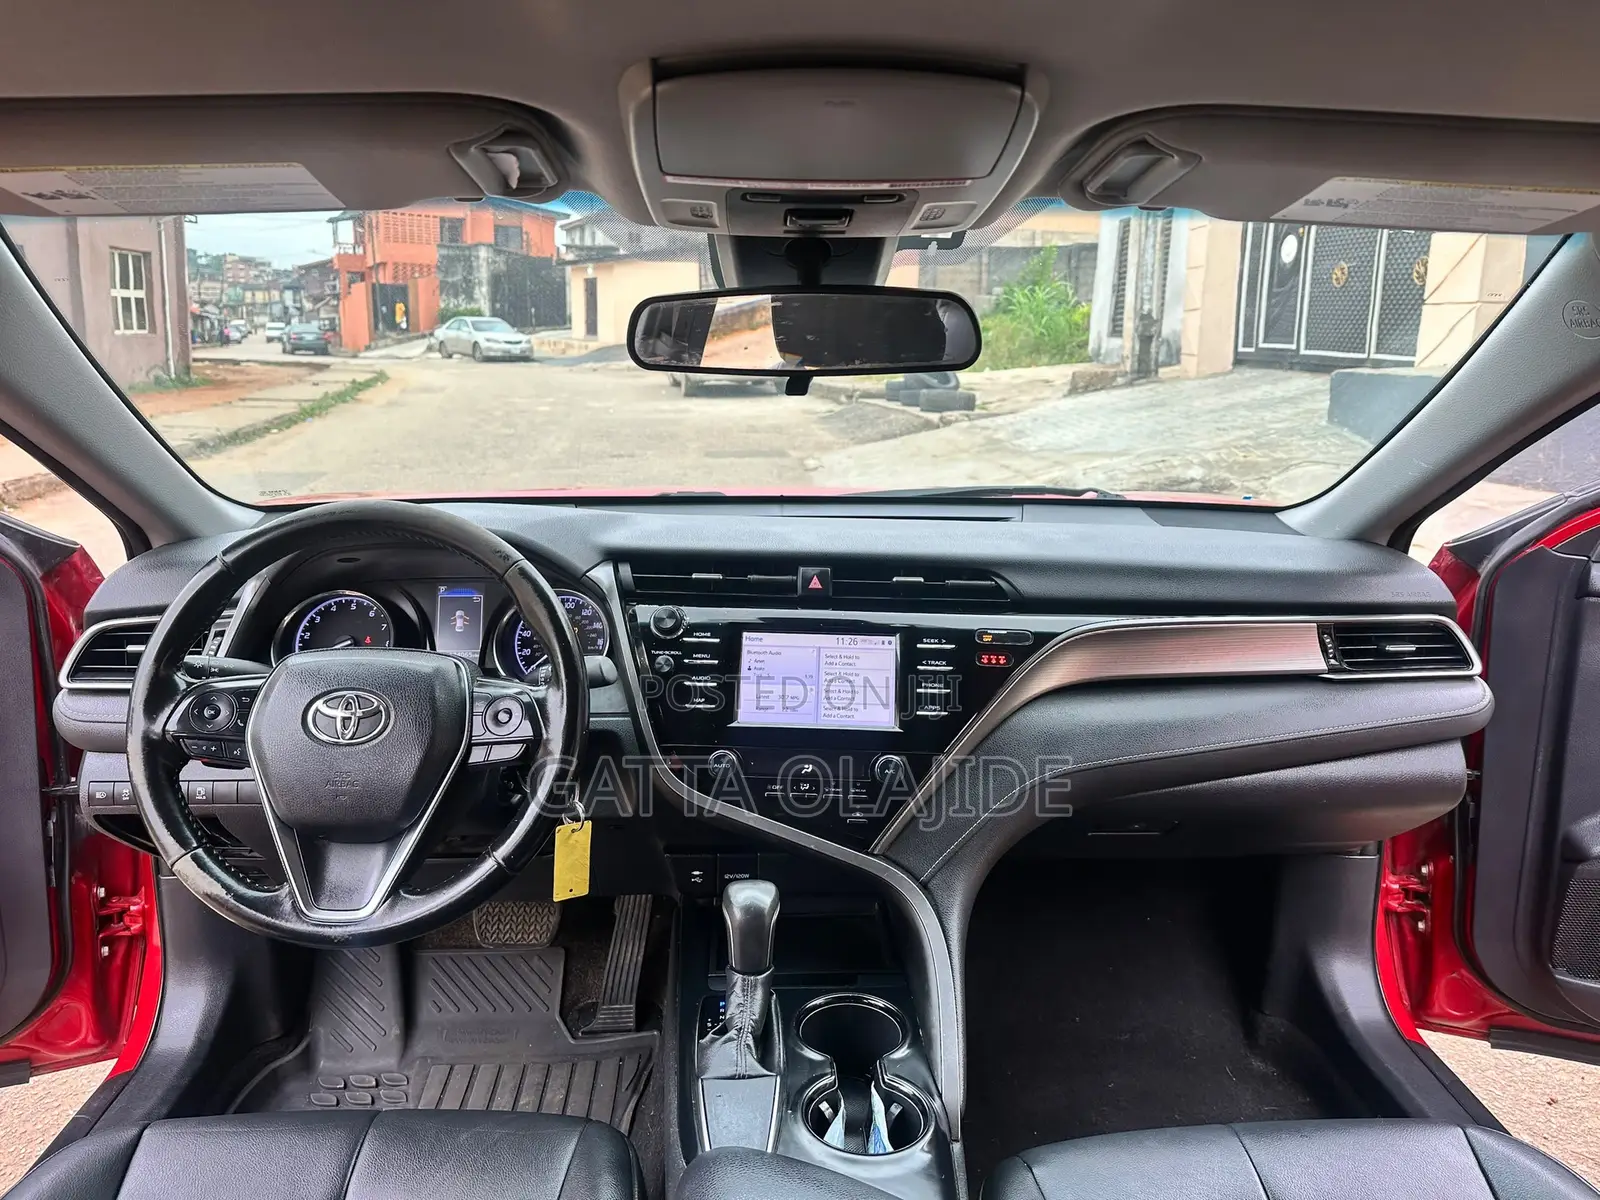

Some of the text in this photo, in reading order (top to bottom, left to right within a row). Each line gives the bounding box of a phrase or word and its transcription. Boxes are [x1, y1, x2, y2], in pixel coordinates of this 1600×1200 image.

[836, 637, 858, 645] 11:26
[334, 771, 351, 780] SRS
[324, 780, 359, 788] AIRBAG
